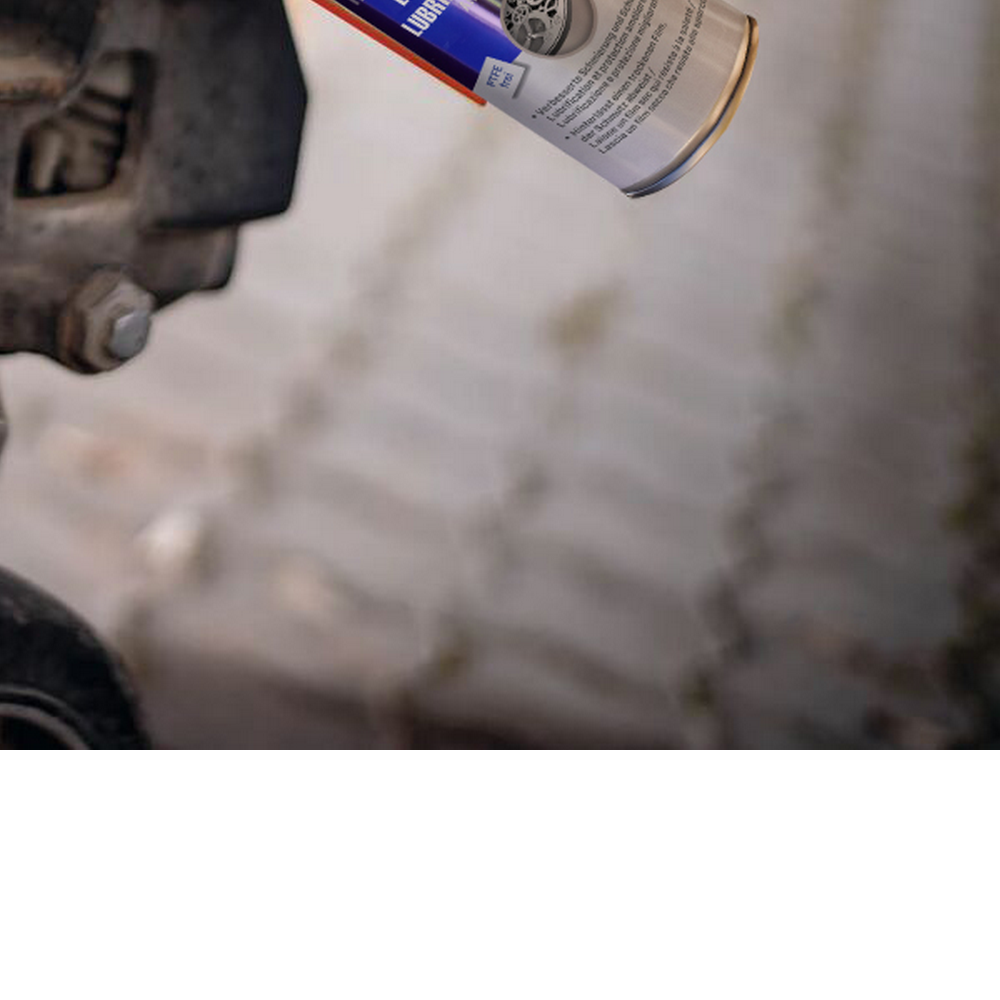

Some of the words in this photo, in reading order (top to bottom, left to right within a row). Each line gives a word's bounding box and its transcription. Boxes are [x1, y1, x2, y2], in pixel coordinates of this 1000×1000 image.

[674, 34, 685, 45] la
[485, 63, 503, 86] PTFE
[535, 74, 583, 116] Verbesserte
[577, 30, 617, 77] Schmierung
[610, 14, 625, 33] und
[545, 78, 595, 123] Lubrification
[590, 69, 603, 81] et
[598, 30, 630, 74] protection
[498, 71, 514, 88] frei
[556, 80, 610, 129] Lubrificazione
[605, 74, 613, 82] e
[610, 34, 642, 79] protezione
[569, 98, 614, 137] Hinterlässt
[611, 79, 632, 102] einen
[627, 39, 657, 82] trockenen
[649, 77, 662, 93] qui
[579, 129, 597, 143] der
[593, 101, 629, 133] Schmutz
[625, 72, 653, 103] abweist
[598, 131, 628, 155] Lascia
[625, 122, 638, 135] un
[633, 109, 651, 125] film
[647, 88, 669, 112] secco
[663, 73, 678, 90] che
[673, 44, 693, 75] resiste
[638, 90, 654, 106] sec
[616, 116, 629, 129] un
[622, 103, 641, 119] film
